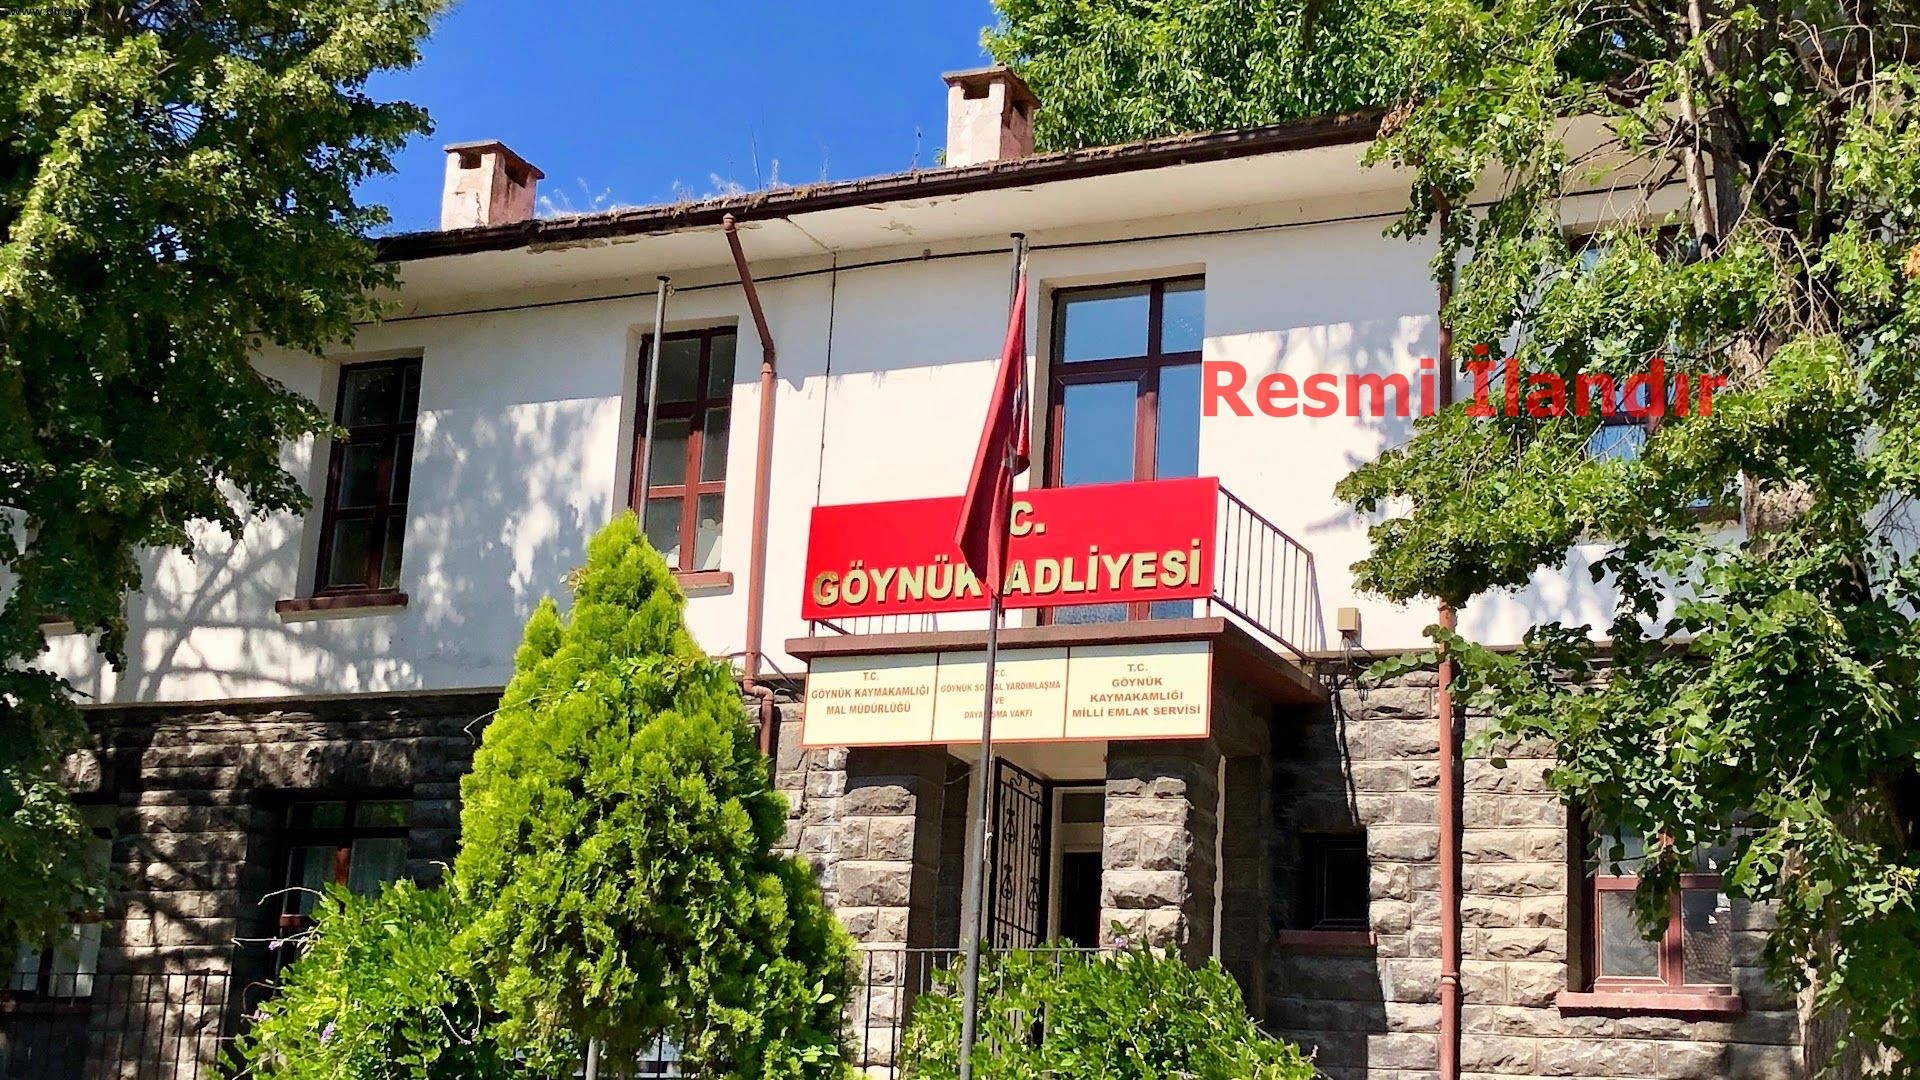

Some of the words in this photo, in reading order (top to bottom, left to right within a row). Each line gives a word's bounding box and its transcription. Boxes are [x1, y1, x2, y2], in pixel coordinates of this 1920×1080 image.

[813, 554, 982, 606] GÖYNÜK
[1003, 538, 1202, 595] ADLİYESİ
[1128, 663, 1148, 672] T.C.
[863, 672, 879, 681] T.C.
[1112, 676, 1163, 687] GÖYNÜK
[811, 687, 852, 699] GÖYNÜK
[854, 684, 930, 698] KAYMAKAMLIĞI
[940, 683, 972, 693] GÖYNÜK
[974, 683, 1003, 692] SOAL
[1006, 681, 1061, 692] YARDIMLAŞMA
[994, 696, 1005, 705] VE
[1090, 690, 1183, 703] KAYMAKAMLIĞI
[826, 705, 846, 715] MAL
[849, 701, 911, 714] MÜDÜRLÜĞÜ
[1072, 707, 1104, 717] MİLLİ
[1108, 706, 1149, 717] EMLAK
[1153, 703, 1201, 716] SERVİSİ
[964, 710, 1008, 719] DAYAŞMA
